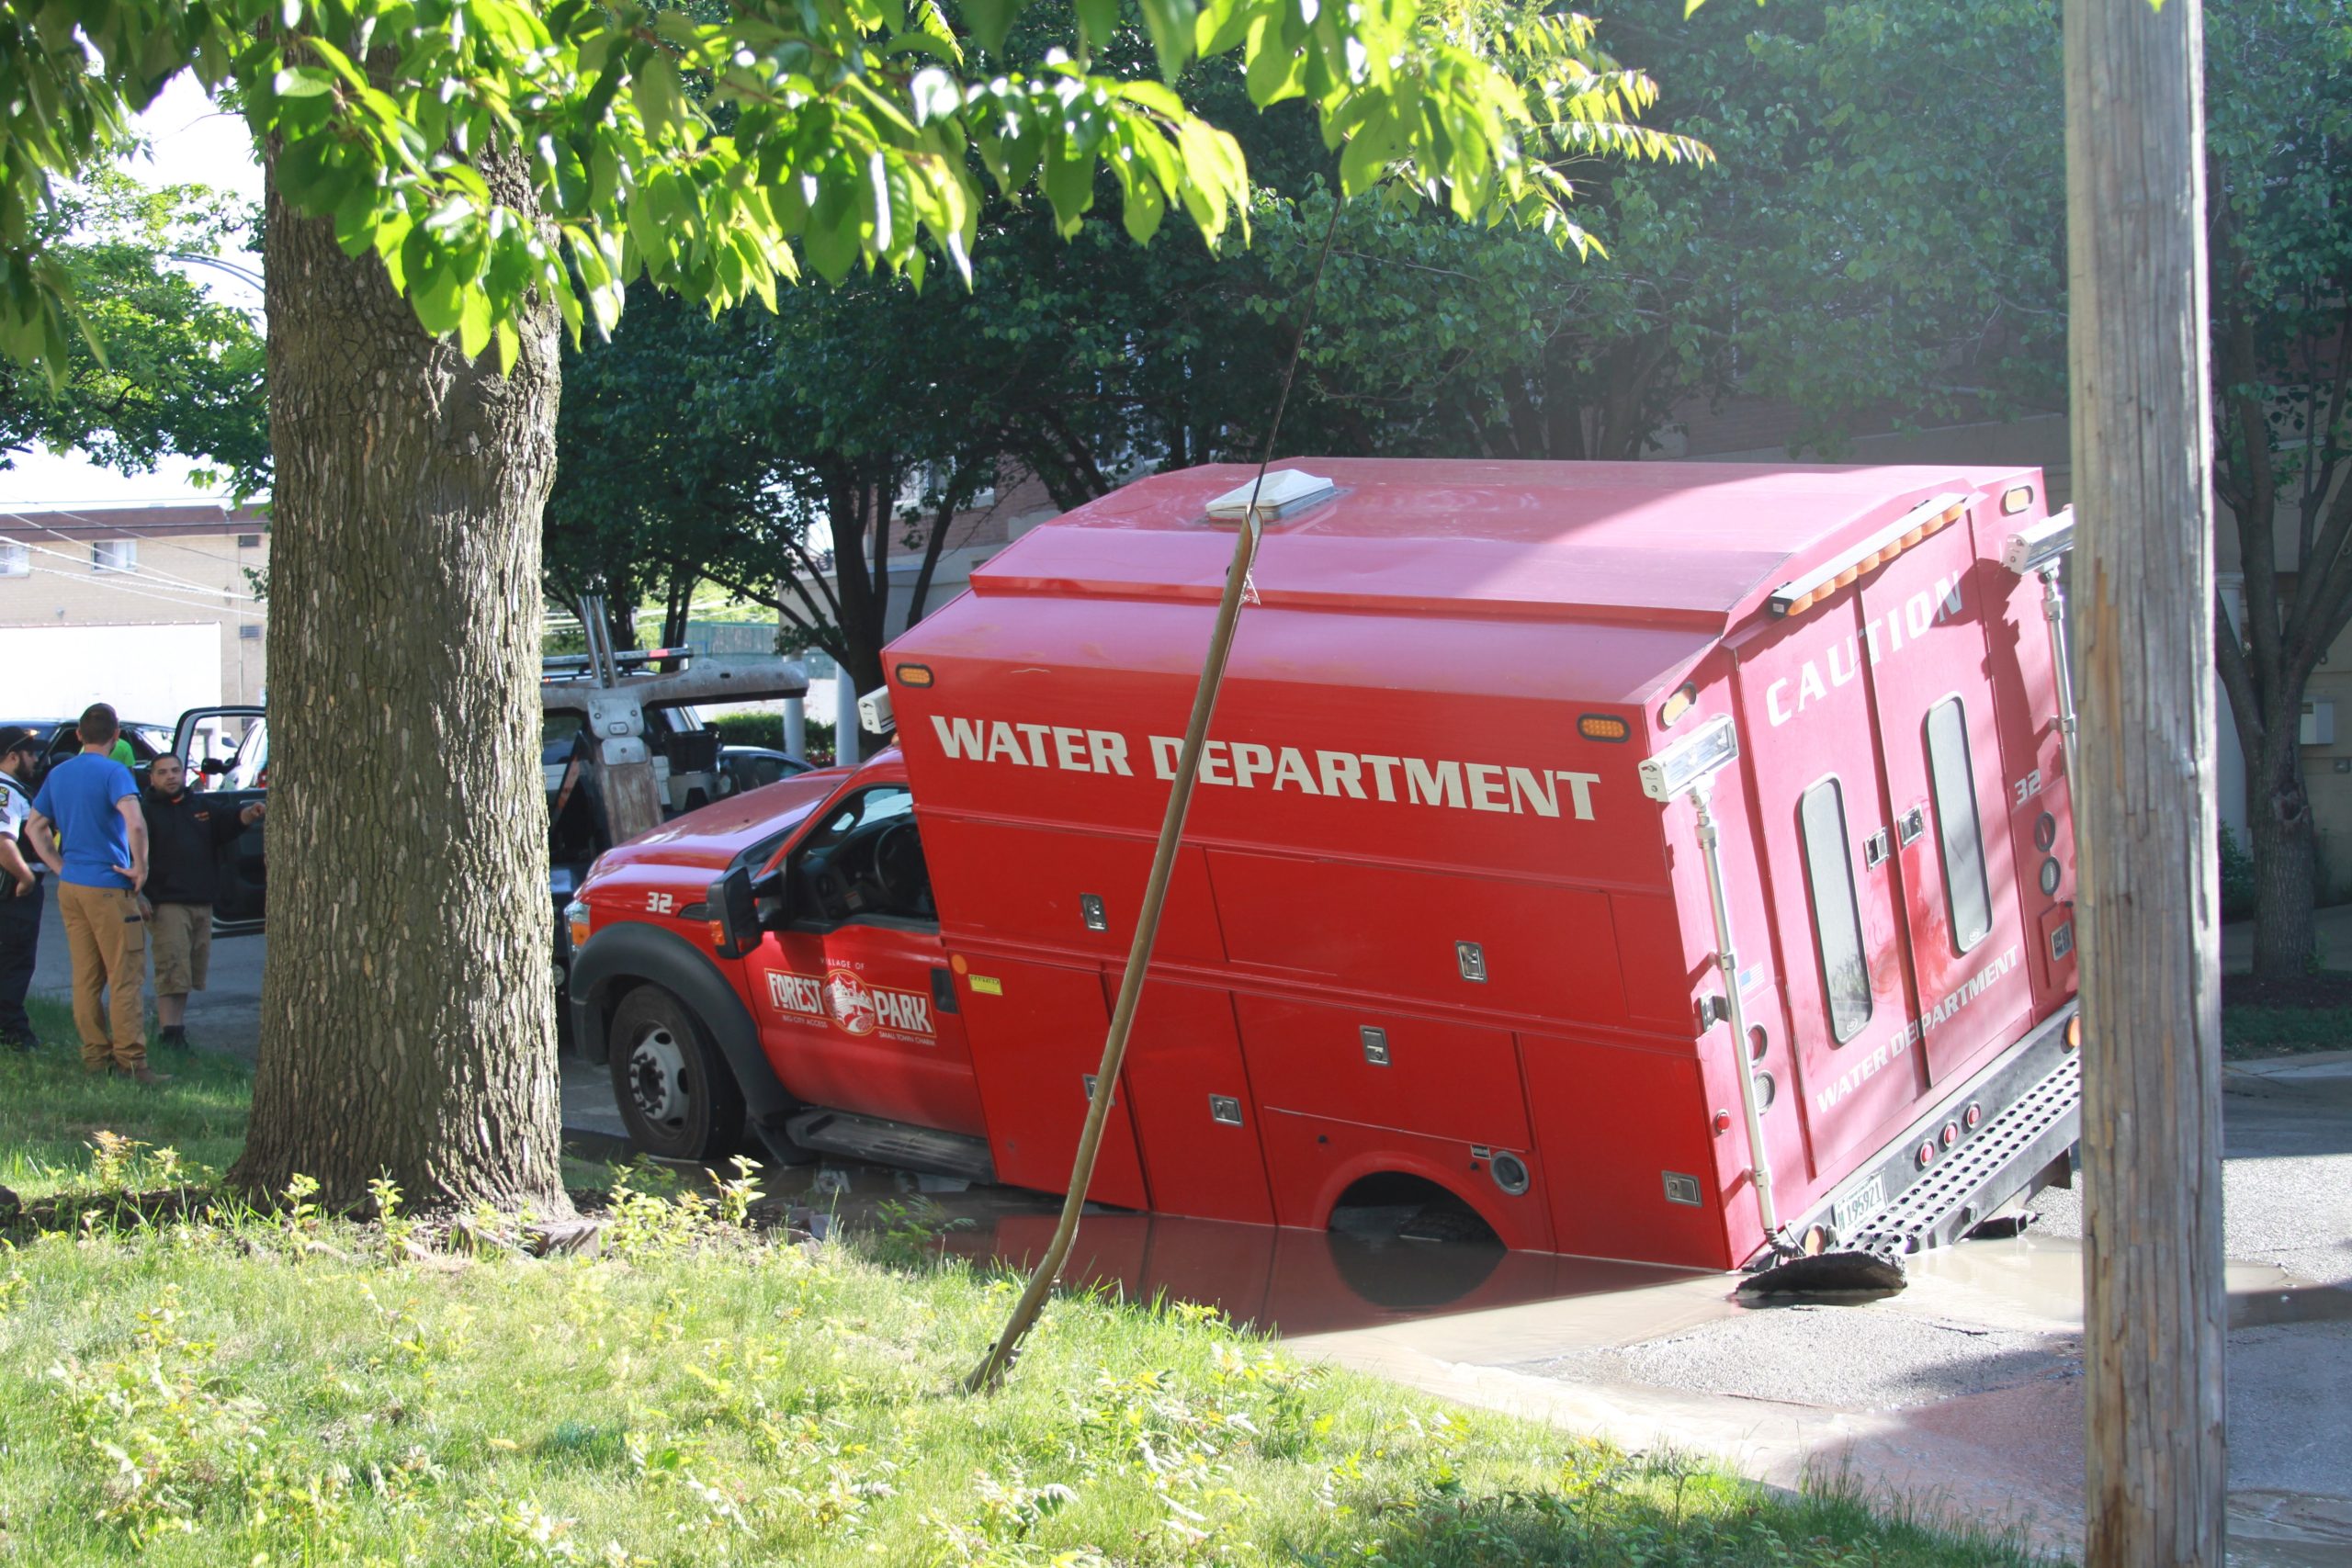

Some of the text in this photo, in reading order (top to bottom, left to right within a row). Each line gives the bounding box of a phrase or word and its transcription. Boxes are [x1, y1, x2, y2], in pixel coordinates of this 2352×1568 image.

[1766, 570, 1963, 728] CAUTION
[930, 716, 1600, 821] WATER DEPARTMENT
[2014, 769, 2041, 806] 32
[646, 891, 673, 914] 32
[820, 957, 851, 968] VILLAGE
[767, 972, 933, 1033] FOREST PARK
[1815, 944, 2018, 1113] WATER DEPARTMENT
